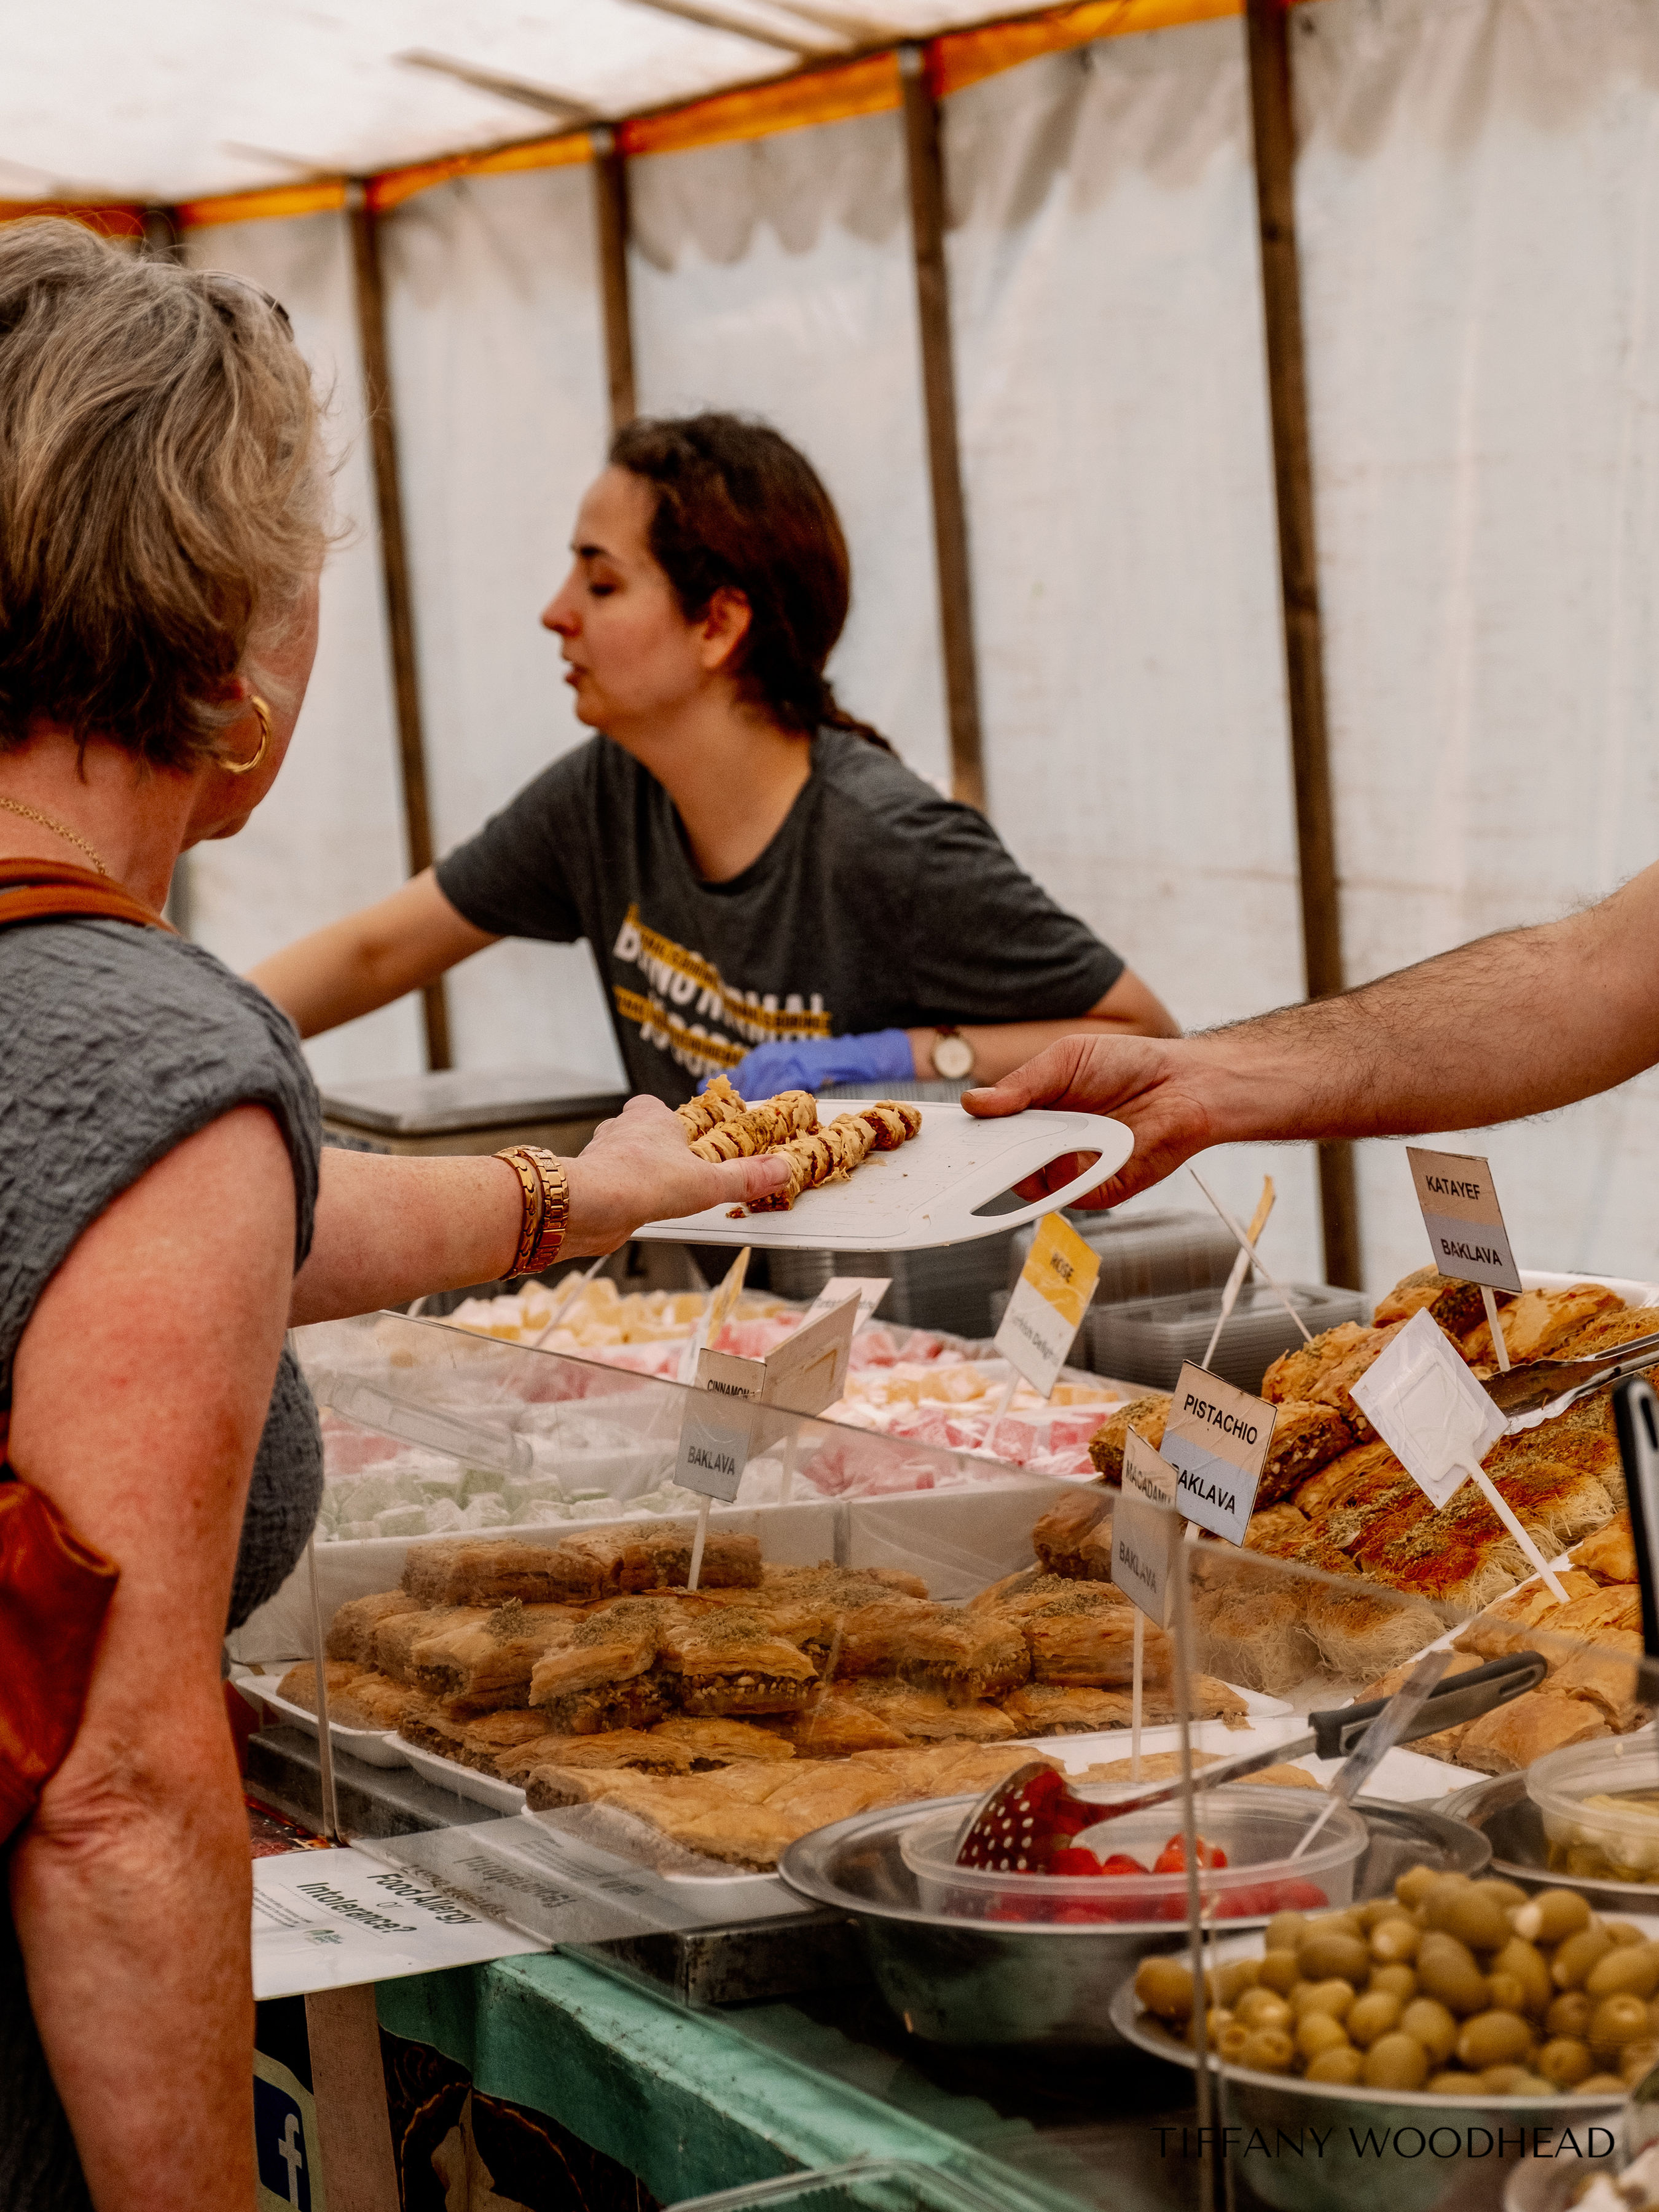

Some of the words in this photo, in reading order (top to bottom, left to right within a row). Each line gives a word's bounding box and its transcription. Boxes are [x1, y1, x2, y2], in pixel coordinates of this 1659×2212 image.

[1425, 1174, 1480, 1200] KATAYEF
[1440, 1238, 1503, 1266] BAKLAVA
[1183, 1393, 1258, 1445] PISTACHIO
[687, 1444, 735, 1476] BAKLAVA
[1125, 1459, 1173, 1507] MACADAMI
[1172, 1463, 1236, 1514] AKLAVA
[1119, 1540, 1158, 1593] BAKLAVA
[296, 1882, 417, 1933] Intolerance?
[367, 1873, 431, 1896] Food
[405, 1895, 482, 1924] Allergy
[376, 1901, 403, 1909] or
